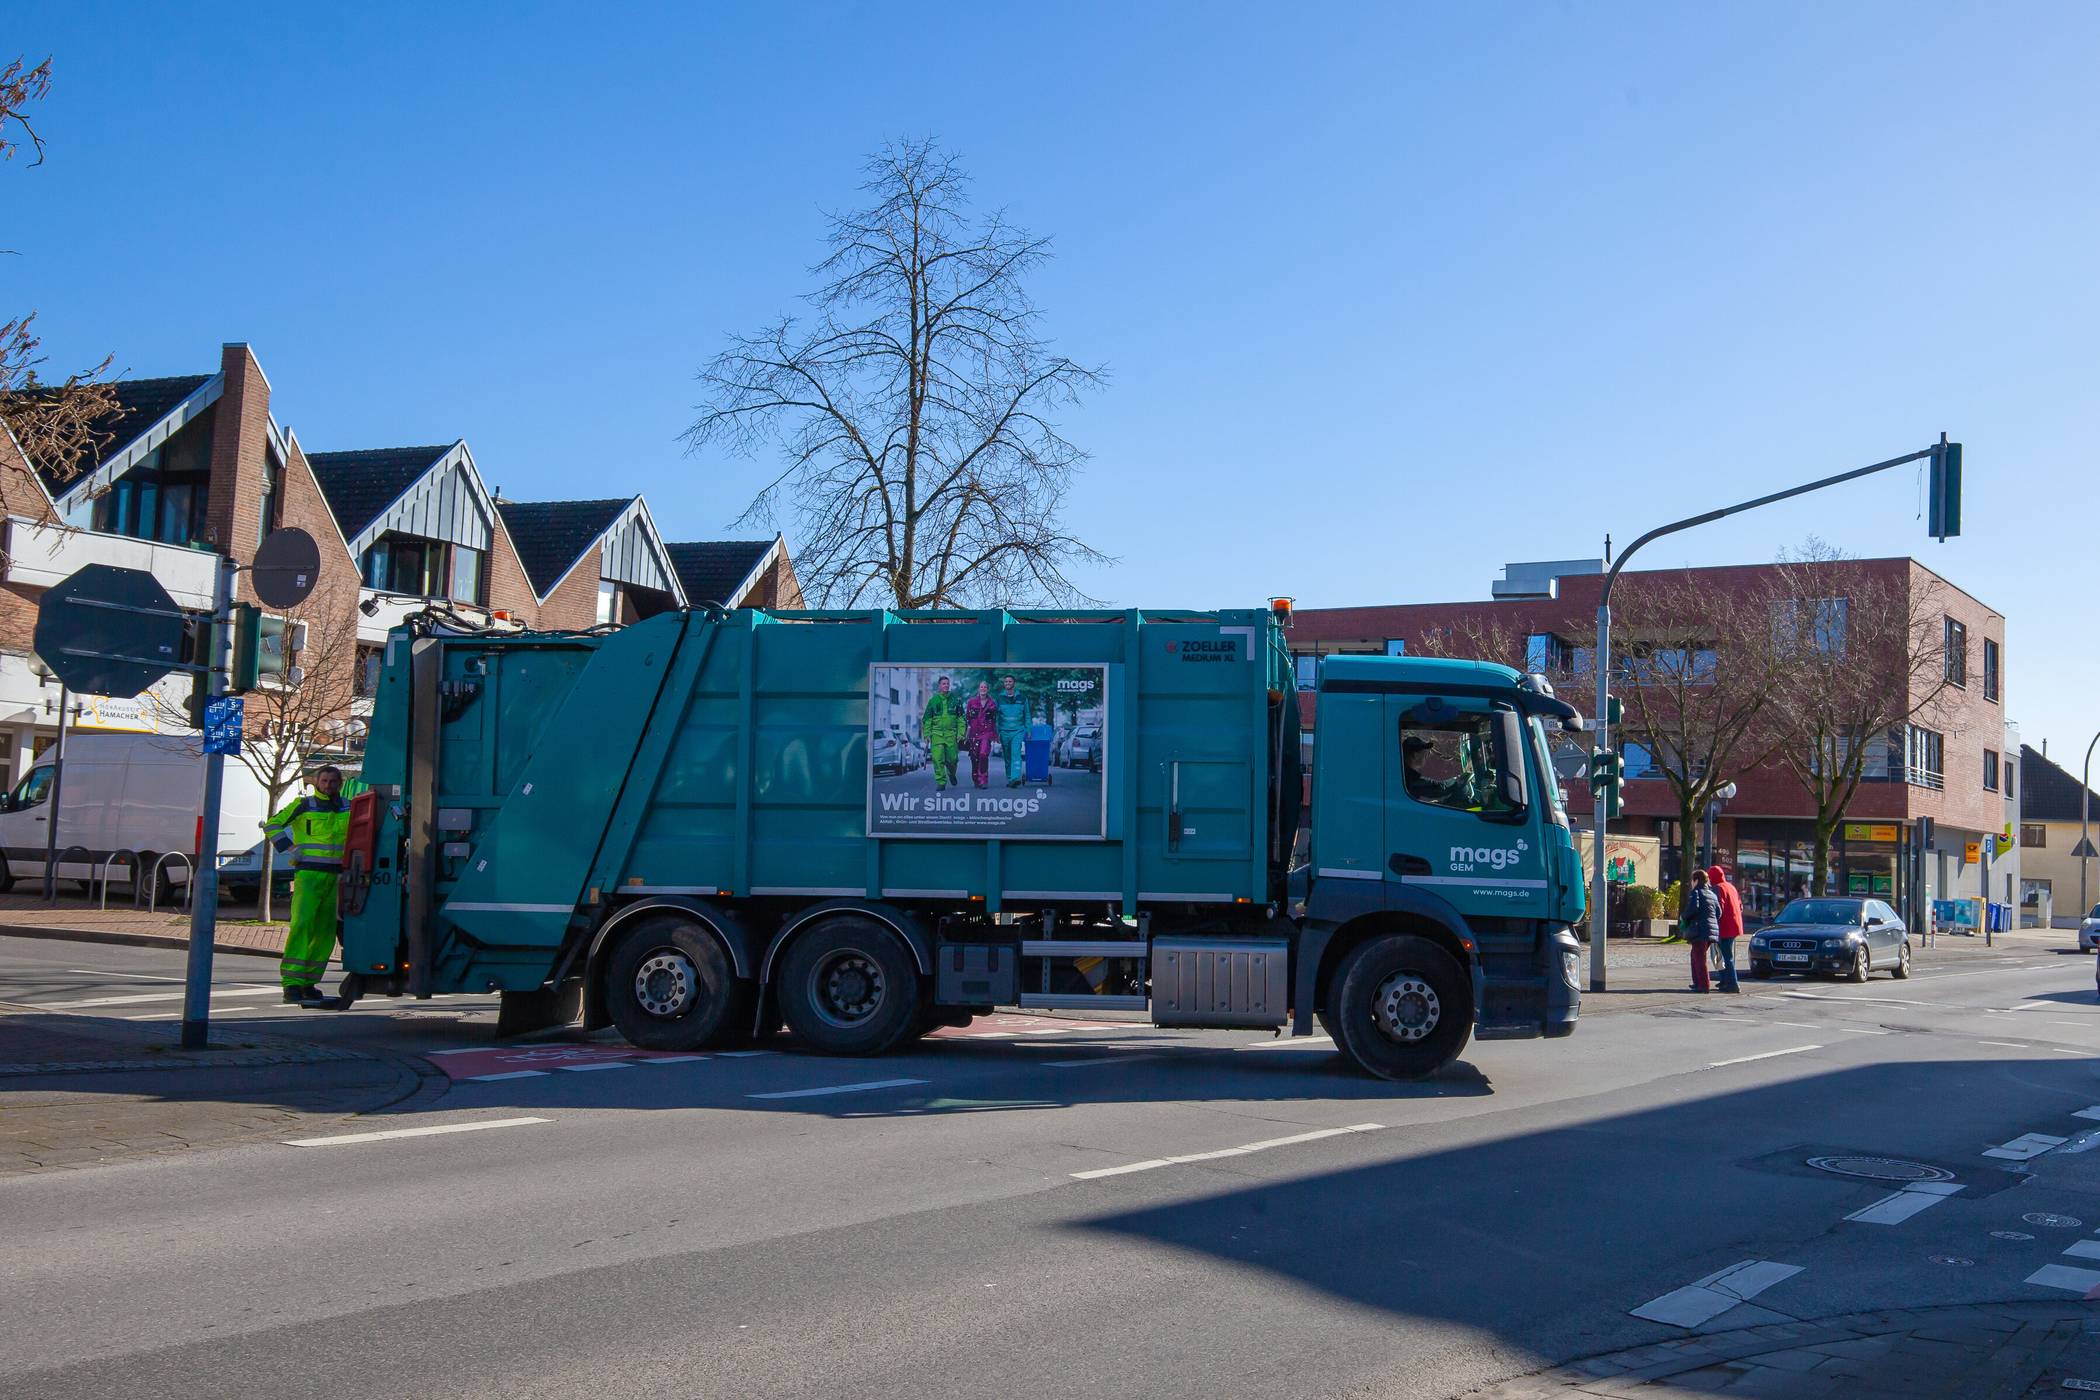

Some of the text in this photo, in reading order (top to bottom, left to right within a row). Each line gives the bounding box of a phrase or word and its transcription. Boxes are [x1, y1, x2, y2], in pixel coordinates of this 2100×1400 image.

[1182, 641, 1236, 652] ZOELLER
[1182, 654, 1236, 663] MEDIUM XL
[1057, 680, 1095, 692] mags
[99, 709, 139, 720] HAMACHER
[880, 792, 1040, 818] Wir sind mags
[1450, 846, 1520, 870] mags
[1450, 863, 1474, 872] GEM
[1473, 889, 1530, 898] www.mags.de
